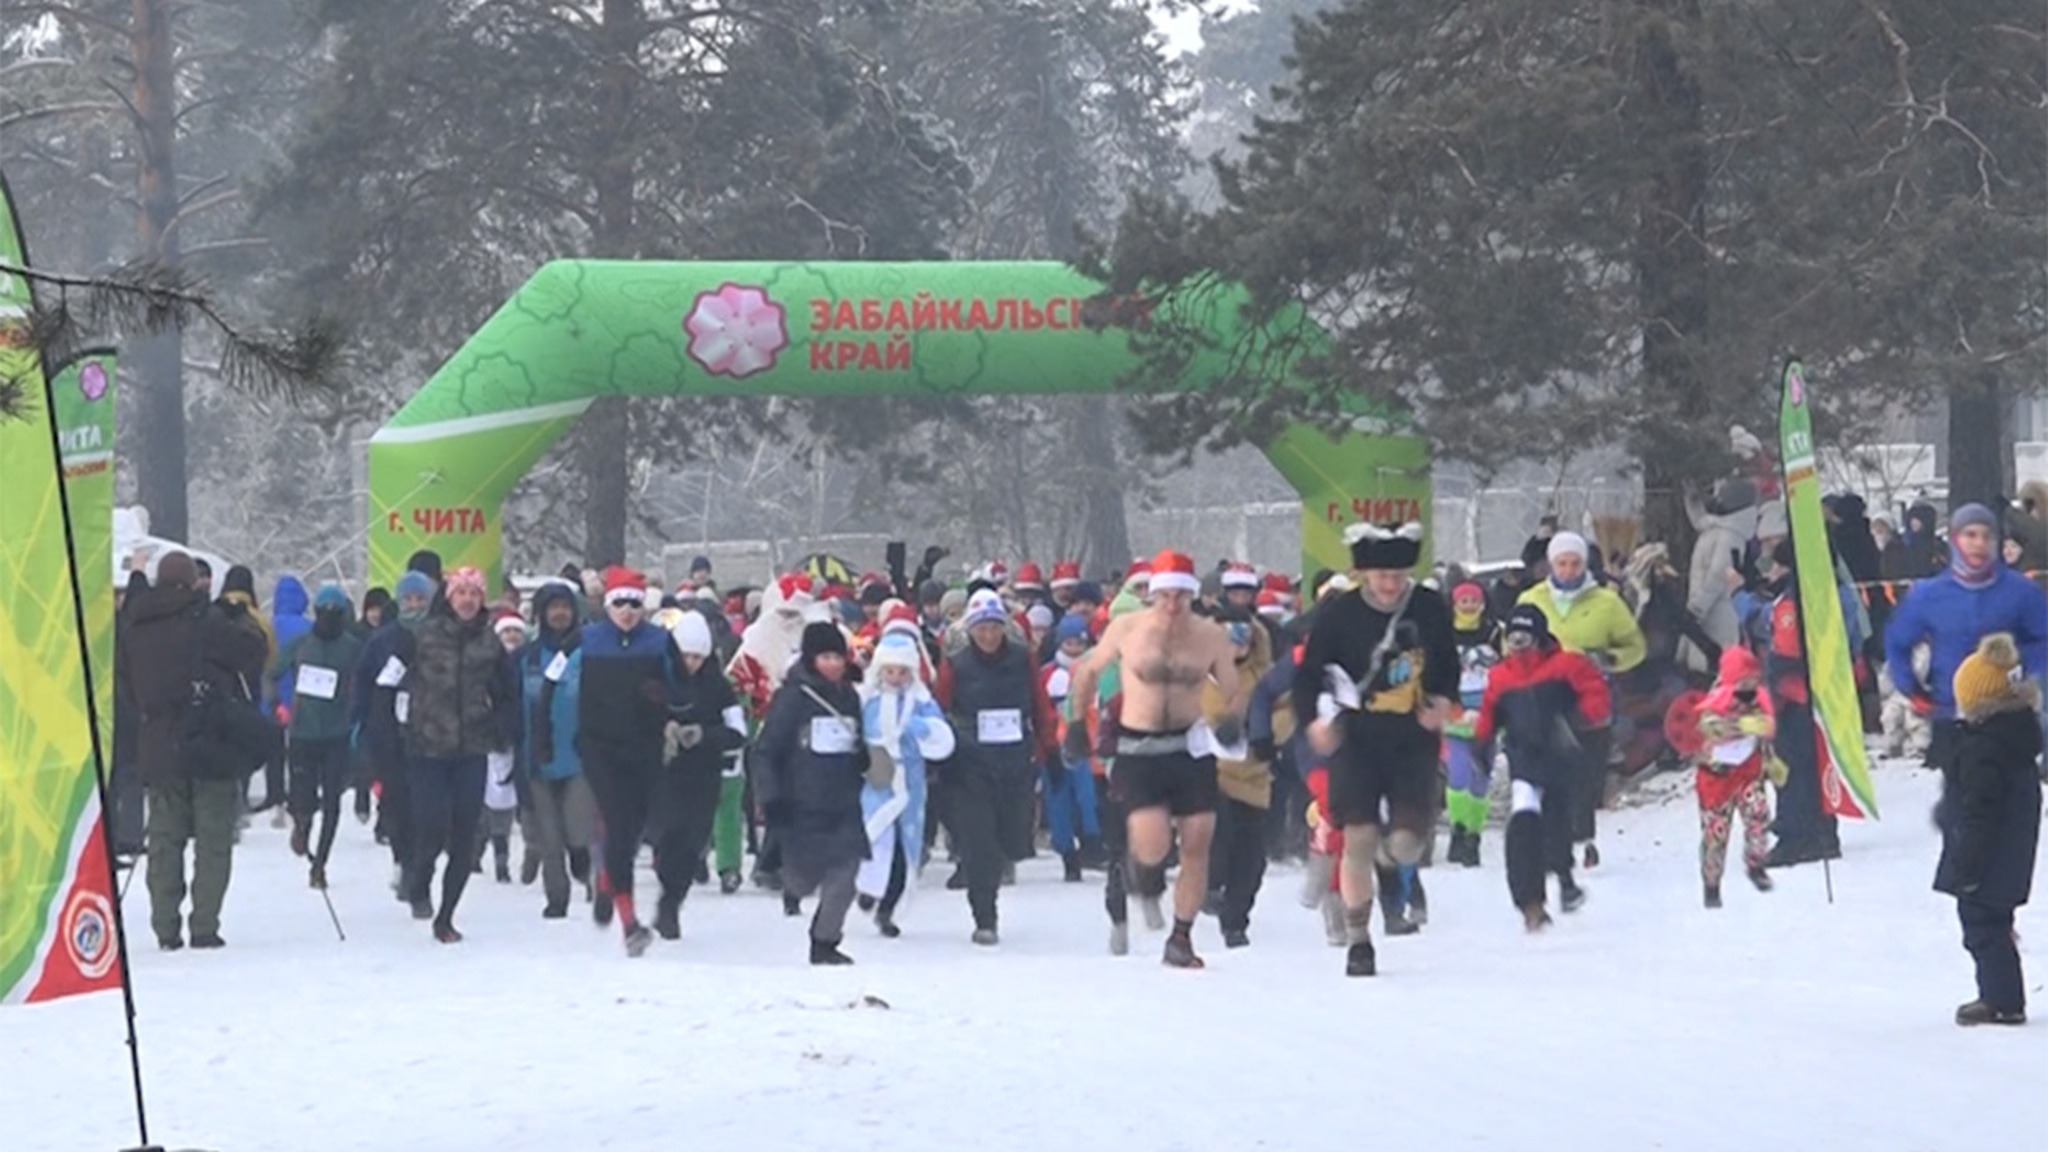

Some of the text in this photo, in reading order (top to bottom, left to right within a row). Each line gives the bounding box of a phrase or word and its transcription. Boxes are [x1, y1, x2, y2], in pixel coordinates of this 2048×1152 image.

[810, 290, 1149, 331] ЗАБАЙКАЛЬС
[810, 333, 910, 371] КРАЙ
[413, 508, 485, 533] ЧИТА
[1352, 498, 1420, 522] ЧИТА
